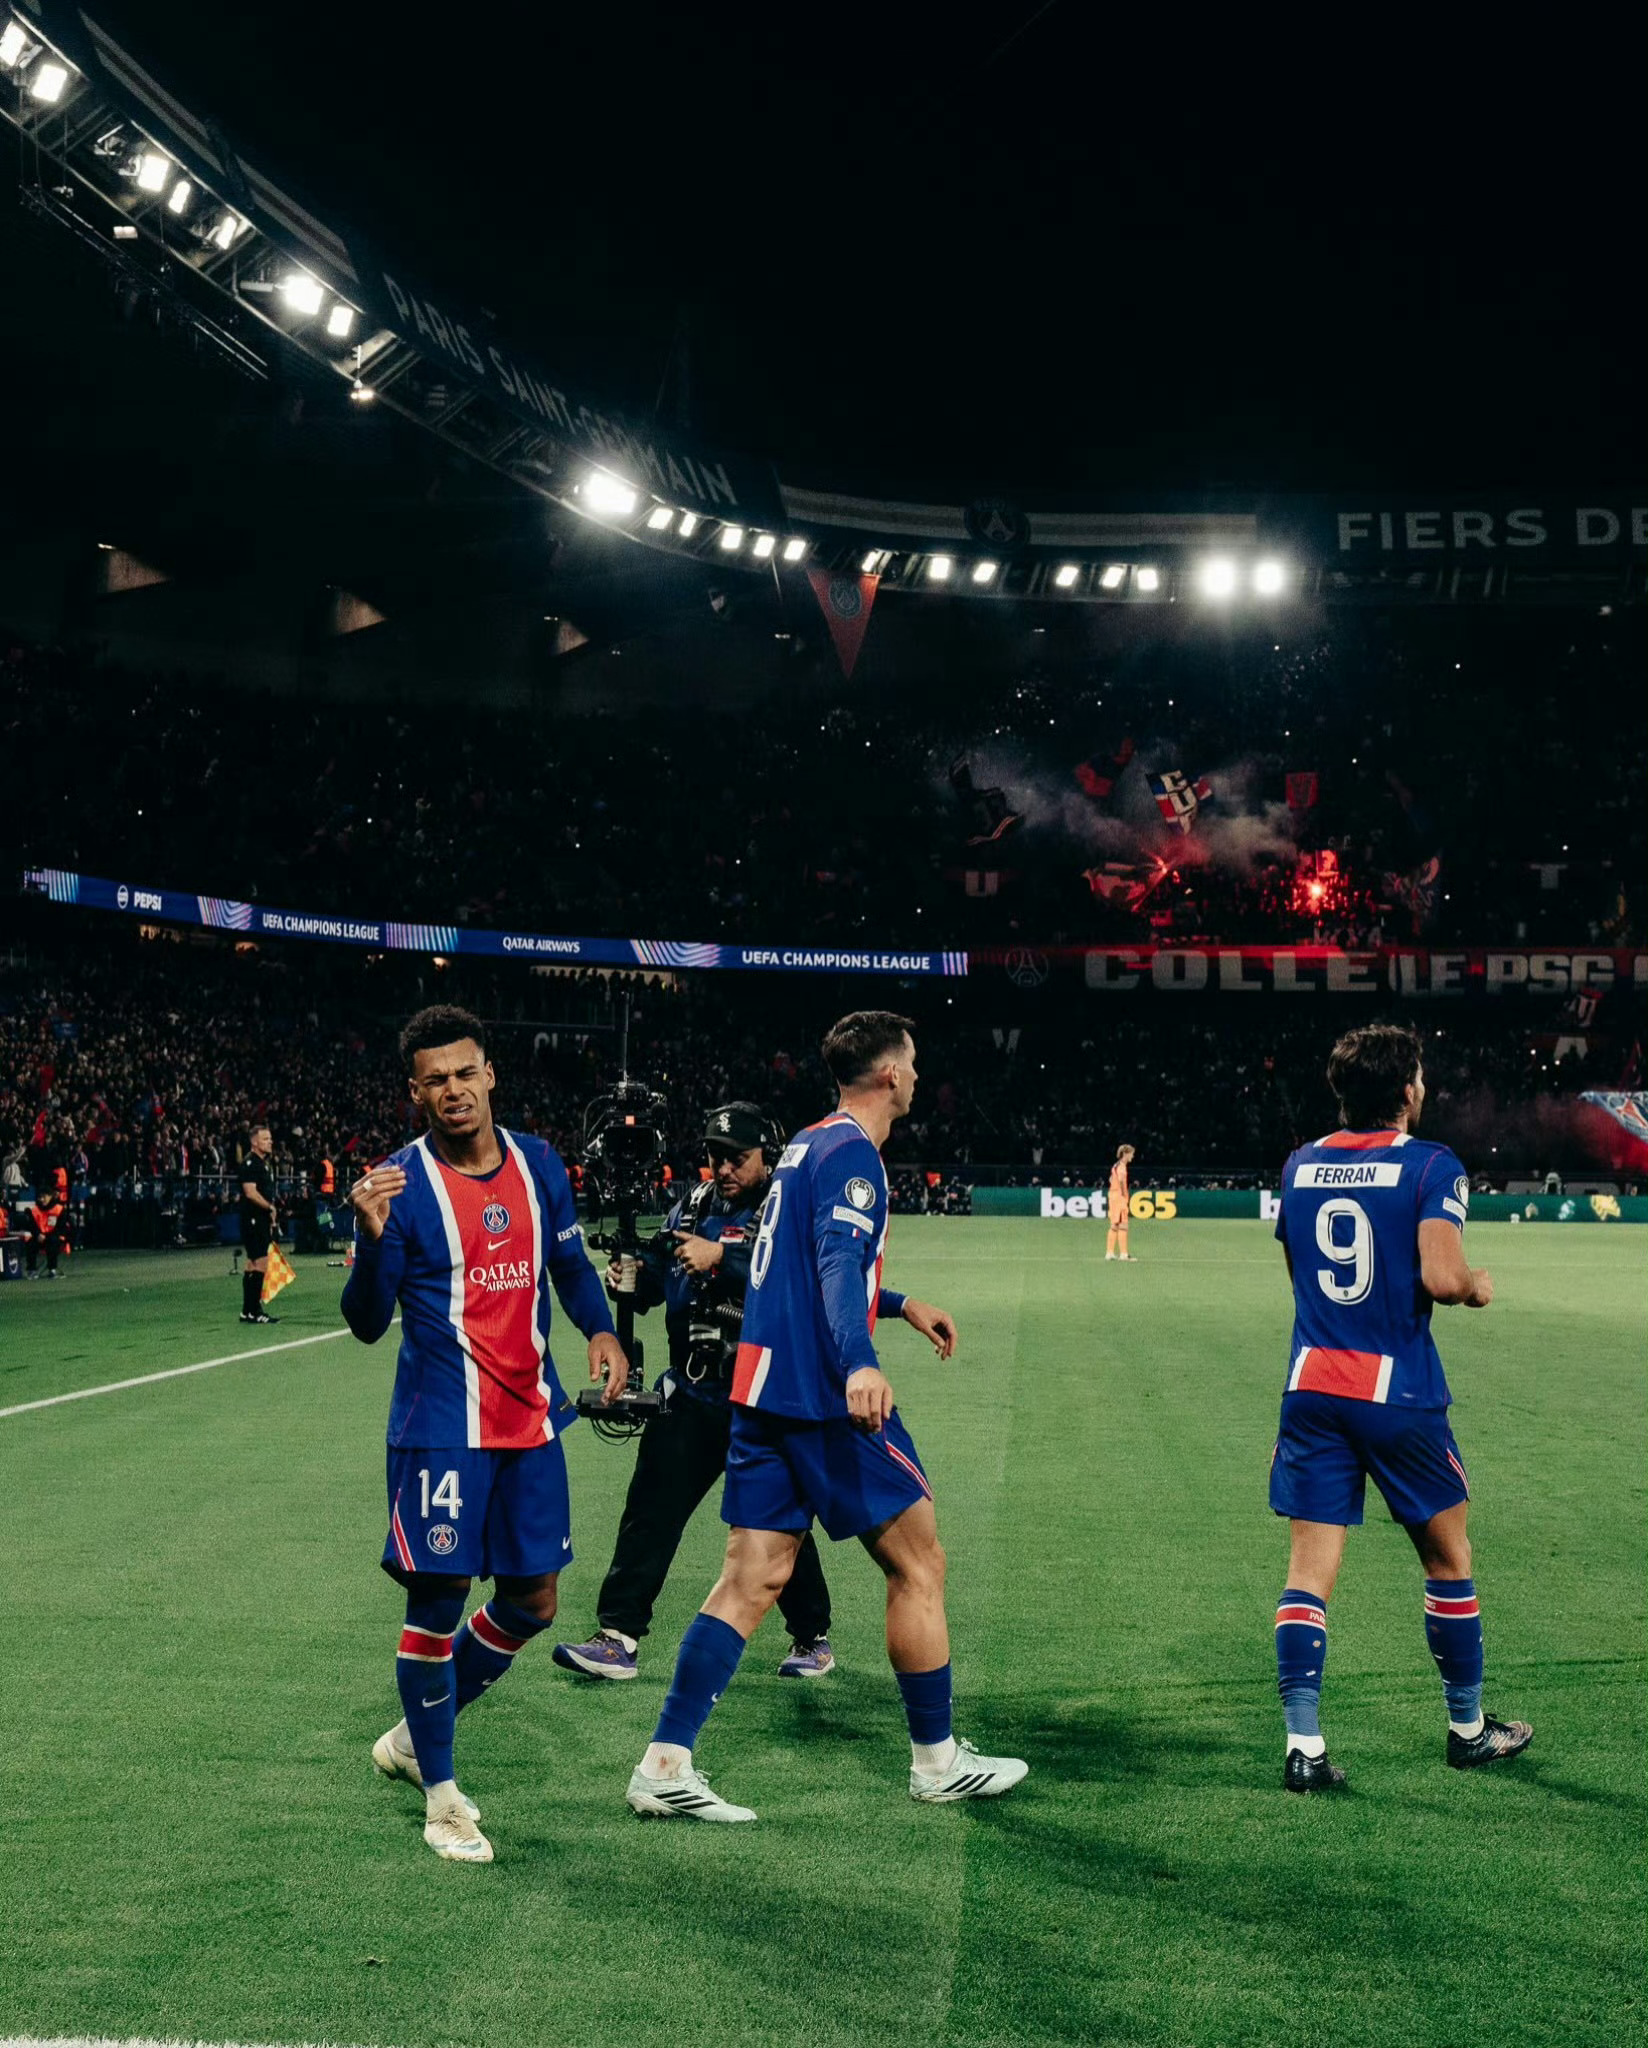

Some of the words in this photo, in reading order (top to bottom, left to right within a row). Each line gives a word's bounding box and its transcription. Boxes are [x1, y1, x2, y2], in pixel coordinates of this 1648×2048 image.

[383, 272, 485, 375] PARIS
[1336, 508, 1548, 550] FIERS
[134, 891, 162, 911] PEPSI
[262, 913, 284, 930] UEFA
[285, 916, 342, 937] CHAMPIONS
[343, 923, 380, 941] LEAGUE
[502, 936, 534, 951] QATAR
[535, 939, 580, 953] AIRWAYS
[742, 951, 780, 966] UEFA
[782, 952, 870, 969] CHAMPIONS
[873, 955, 931, 970] LEAGUE
[1485, 954, 1616, 995] PSG
[1314, 1166, 1376, 1184] FERRAN
[1041, 1187, 1177, 1220] bet65
[1315, 1198, 1374, 1305] 9
[469, 1260, 530, 1286] QATAR
[486, 1277, 531, 1292] AIRWAYS
[418, 1469, 463, 1519] 14
